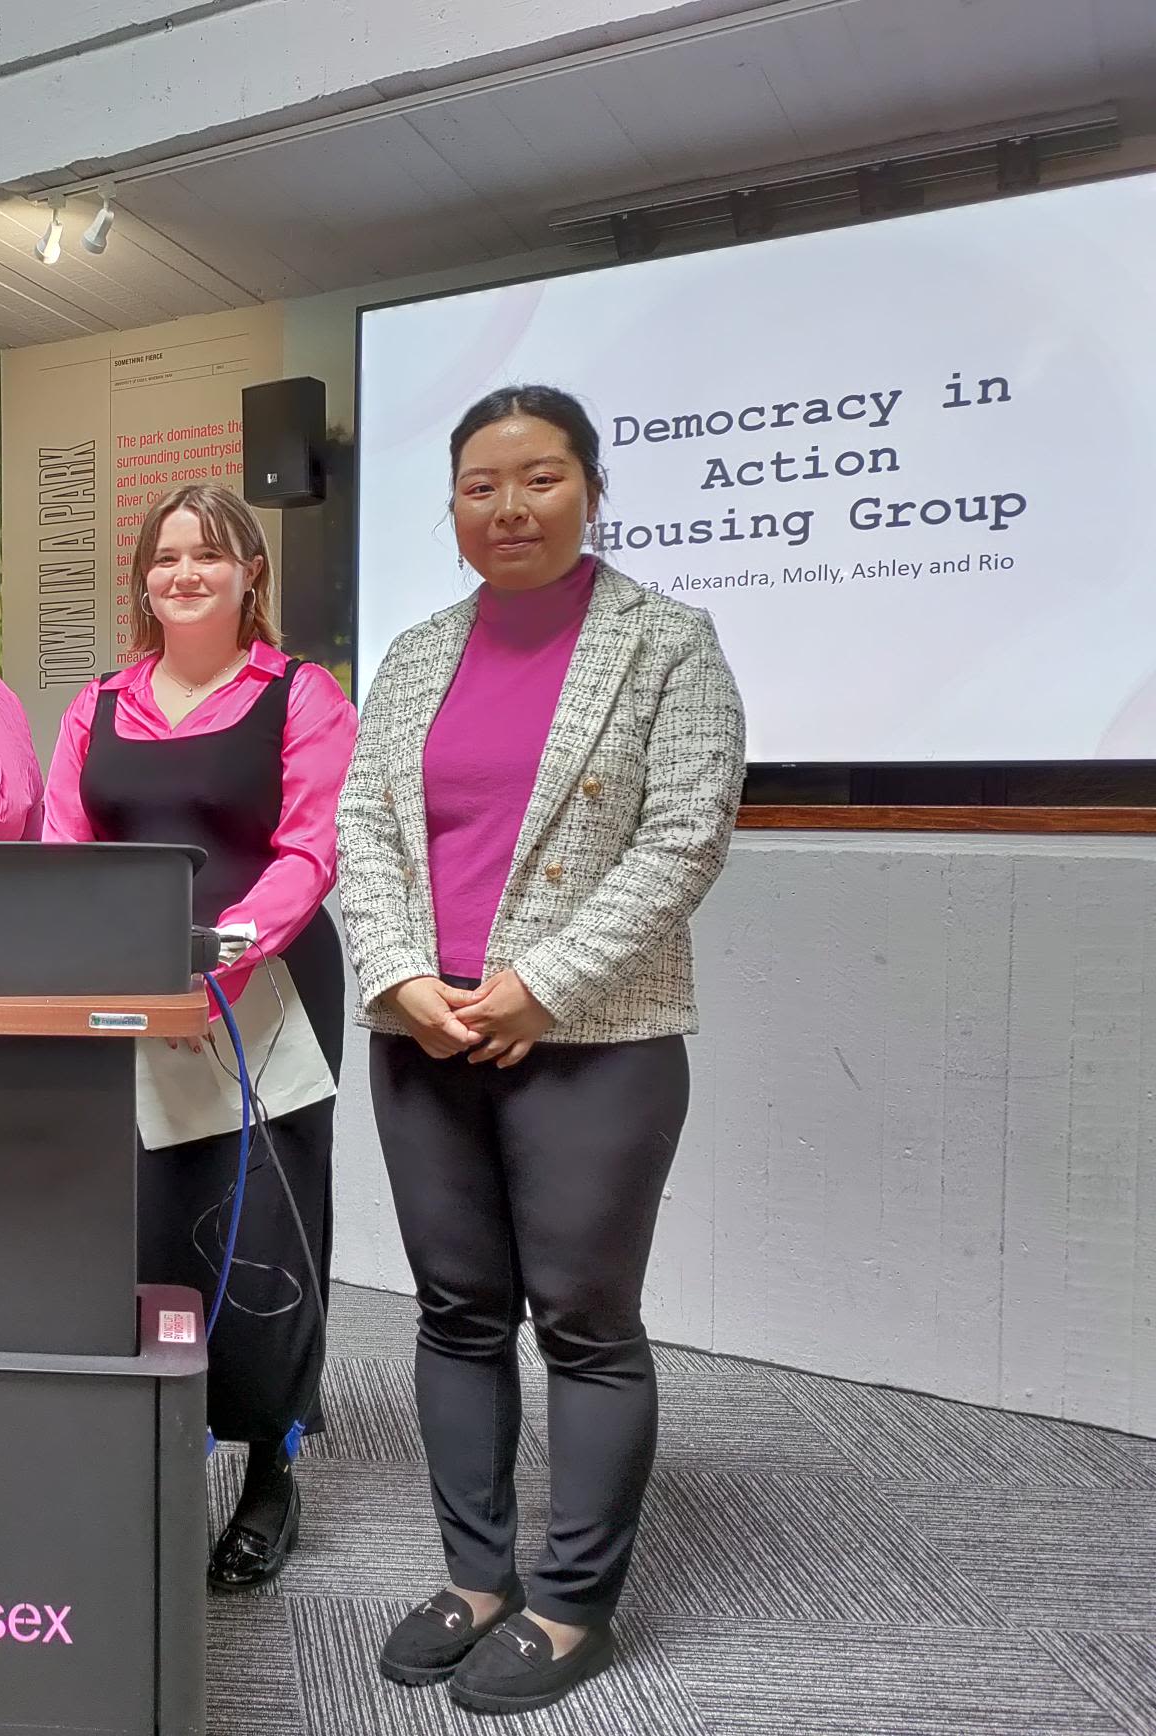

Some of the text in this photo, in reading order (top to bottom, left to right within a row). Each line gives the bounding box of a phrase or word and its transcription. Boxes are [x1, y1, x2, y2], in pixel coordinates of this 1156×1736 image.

[114, 353, 163, 367] SOMETHING FIERCE
[612, 372, 1011, 446] Democracy in
[116, 435, 137, 448] The
[139, 431, 164, 448] park
[167, 423, 224, 441] dominates
[116, 440, 244, 468] surrounding countrysid
[116, 461, 243, 488] and looks across to the
[701, 446, 900, 490] Action
[116, 494, 143, 508] River
[116, 512, 147, 528] archi
[597, 491, 1027, 551] Housing Group
[39, 440, 95, 689] TOWN IN A PARK
[672, 569, 775, 591] Alexandra,
[783, 564, 845, 585] Molly,
[851, 560, 922, 580] Ashley
[929, 554, 969, 574] and
[979, 552, 1014, 571] Rio
[116, 632, 127, 644] to
